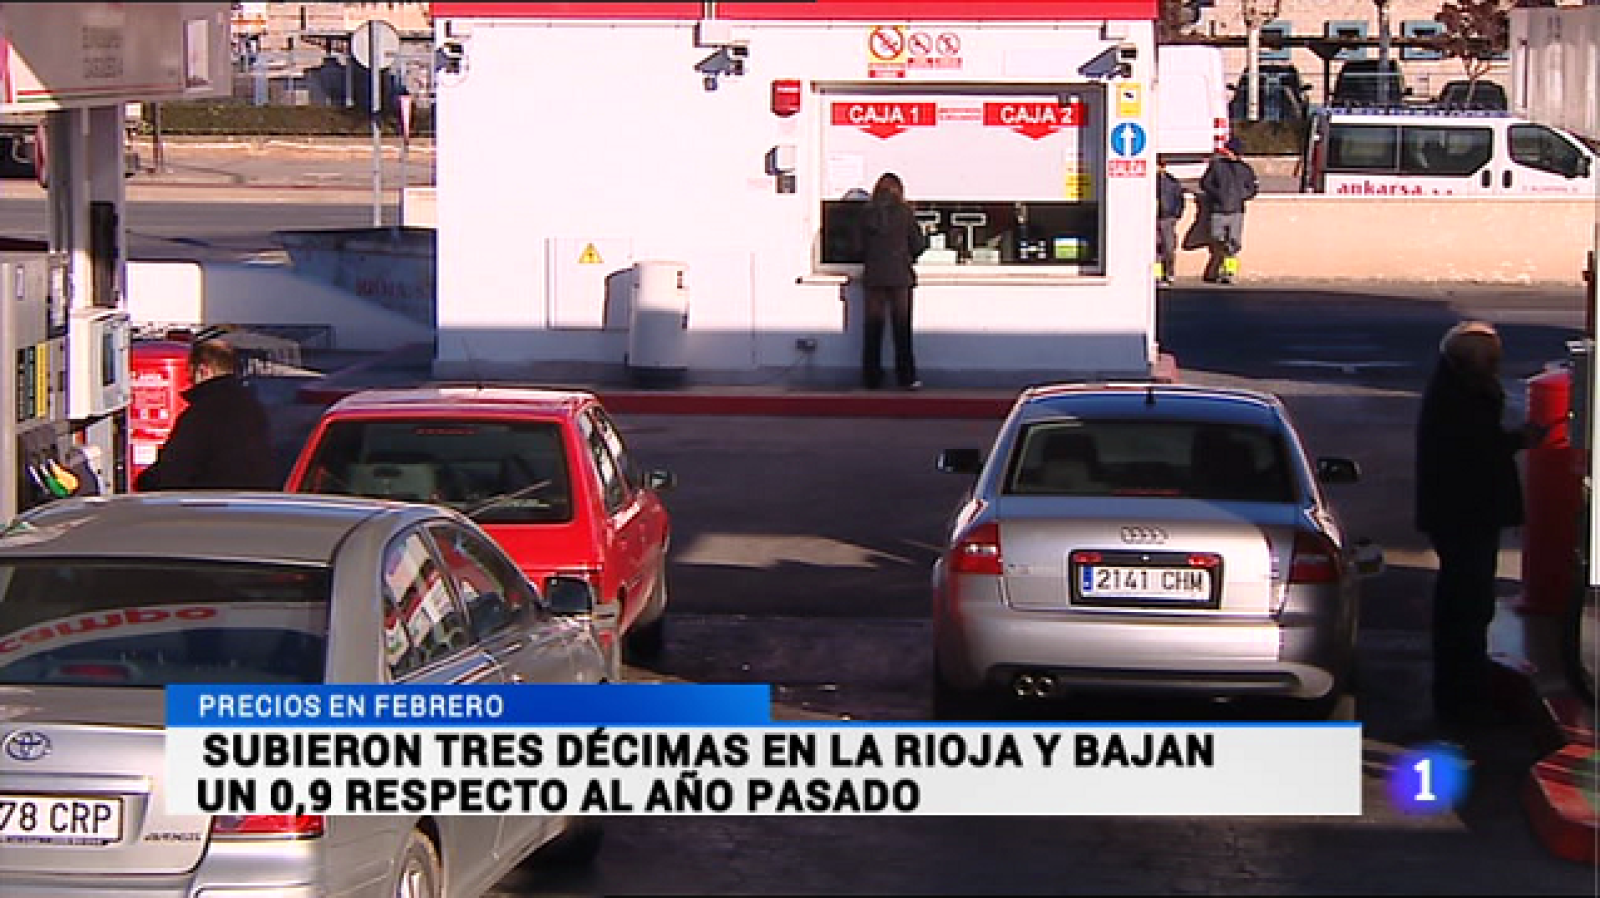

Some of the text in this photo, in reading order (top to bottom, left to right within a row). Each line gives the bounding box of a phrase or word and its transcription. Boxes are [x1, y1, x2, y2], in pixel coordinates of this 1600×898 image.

[848, 104, 905, 124] CAJA
[909, 104, 920, 124] 1
[999, 104, 1056, 124] CAJA
[1058, 105, 1074, 124] 2
[1097, 568, 1149, 590] 2141
[50, 802, 113, 834] CRP
